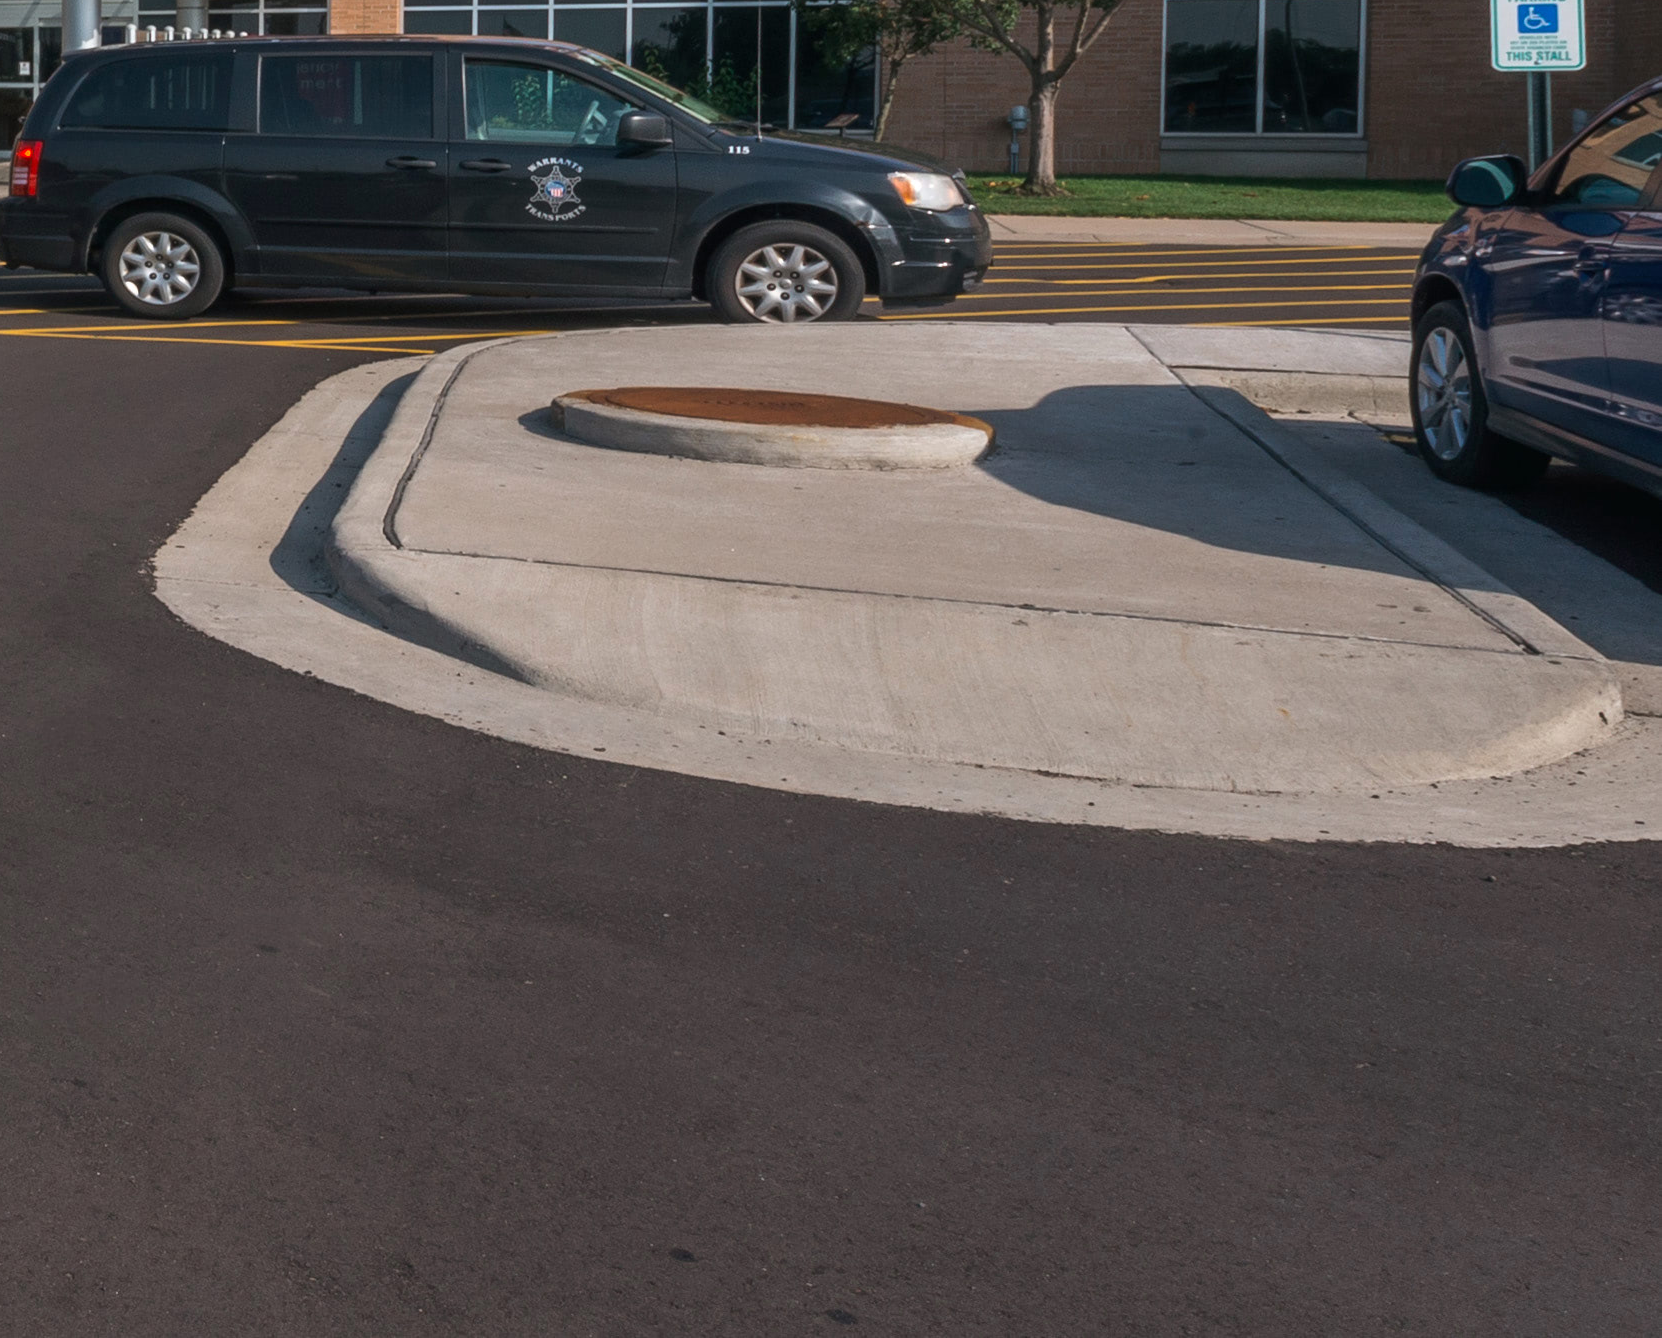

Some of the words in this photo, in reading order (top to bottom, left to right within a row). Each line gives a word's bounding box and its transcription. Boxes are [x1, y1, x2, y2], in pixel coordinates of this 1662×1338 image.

[1506, 51, 1533, 61] THIS
[1536, 51, 1572, 61] STALL
[728, 145, 750, 154] 115
[527, 157, 584, 173] WARRANTS
[525, 203, 586, 221] TRANSPORTS
